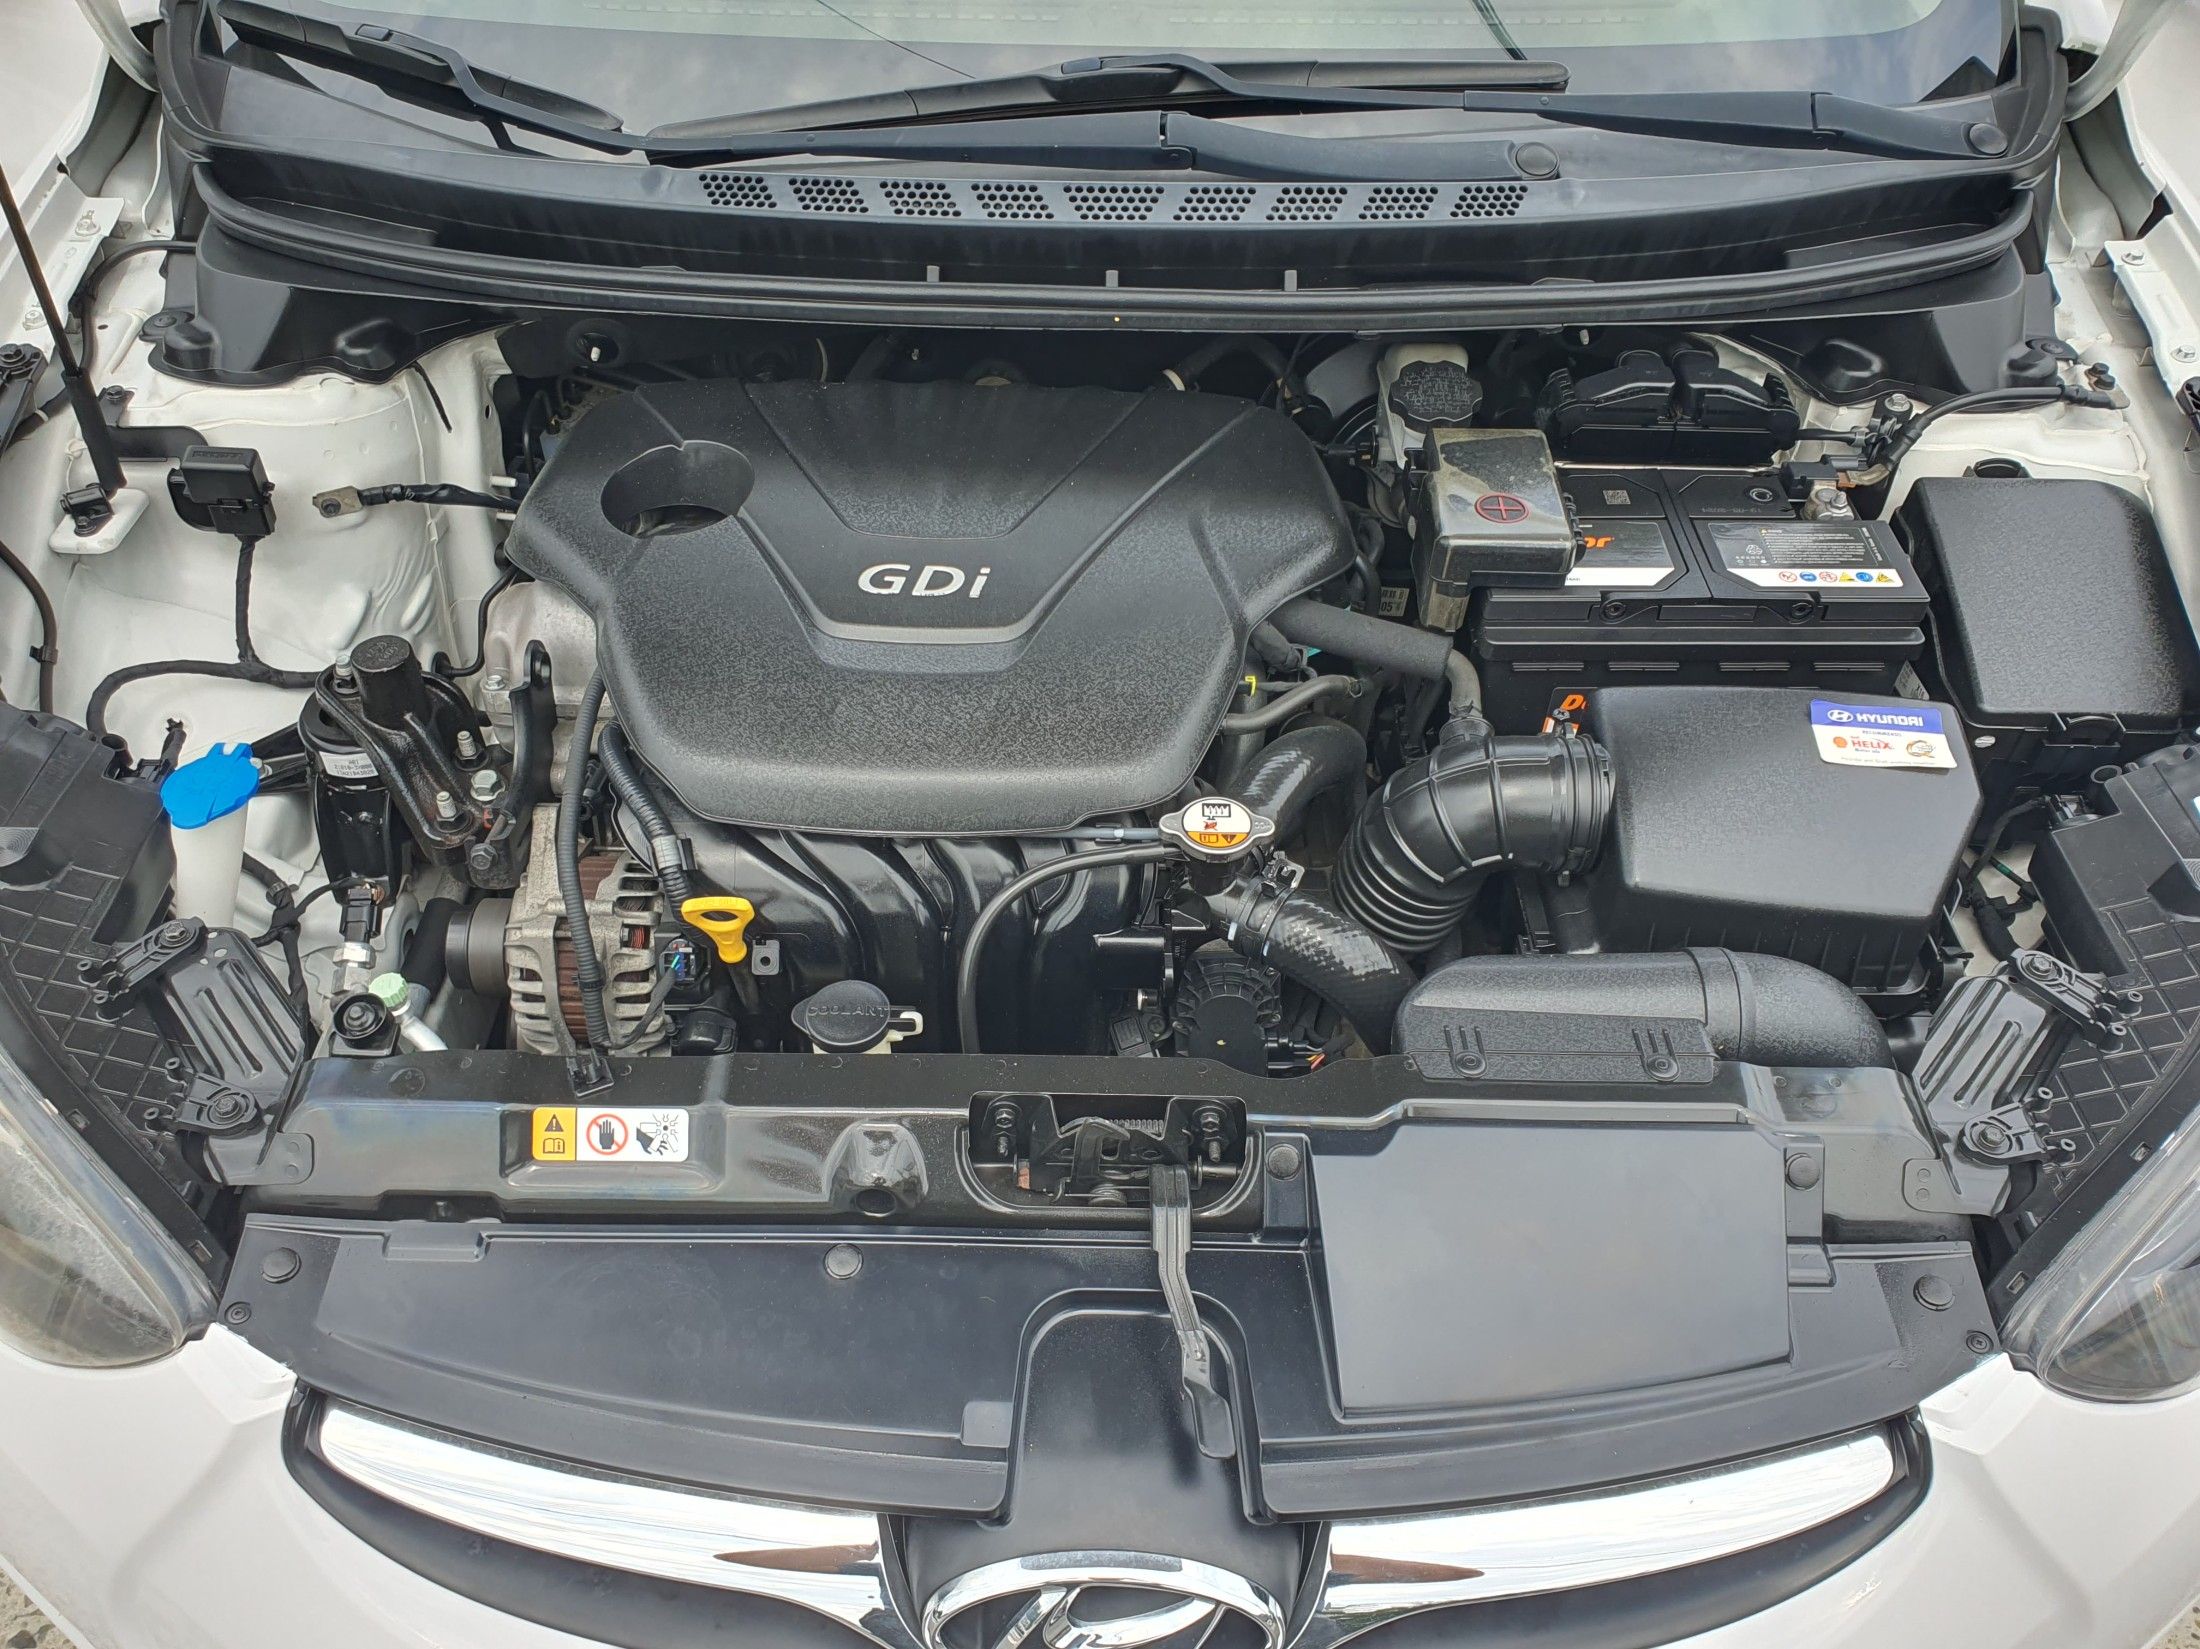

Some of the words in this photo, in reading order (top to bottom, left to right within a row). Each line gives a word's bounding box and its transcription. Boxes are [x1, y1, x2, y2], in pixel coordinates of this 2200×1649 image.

[857, 563, 991, 598] GDi
[1560, 694, 1587, 711] D
[1856, 712, 1924, 727] HYUNDAI
[1851, 738, 1893, 750] HELIX
[807, 1004, 888, 1017] COOLANT
